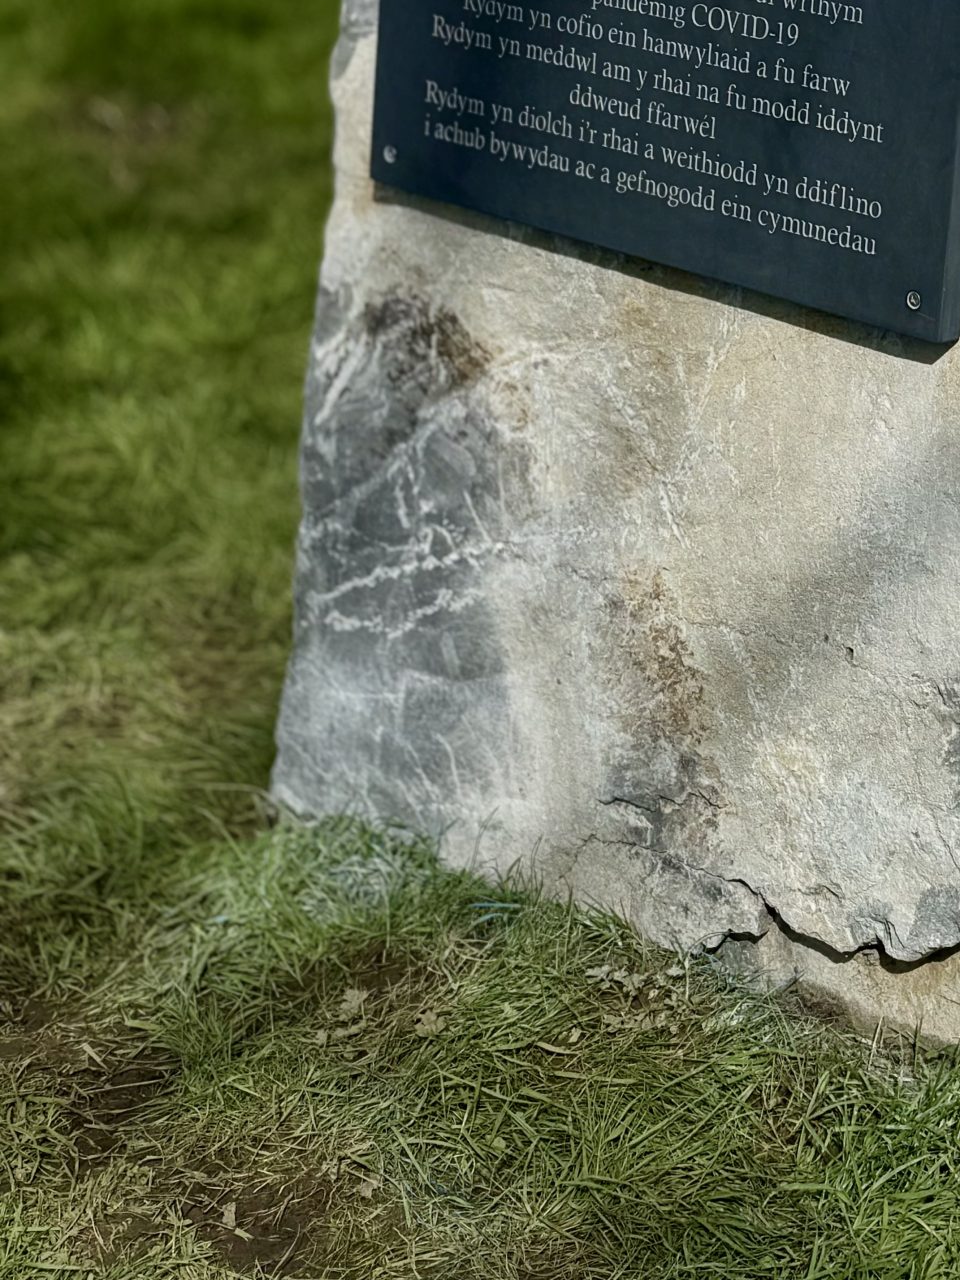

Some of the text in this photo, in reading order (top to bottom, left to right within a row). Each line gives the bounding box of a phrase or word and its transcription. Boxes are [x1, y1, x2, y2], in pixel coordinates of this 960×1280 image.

[431, 14, 885, 144] Rydym yn meddwl am y rhai na fu modd iddynt
[528, 8, 552, 31] yn
[556, 13, 604, 40] cofio
[607, 21, 637, 49] ein
[641, 27, 751, 74] hanwyliaid
[756, 61, 768, 79] a
[773, 57, 795, 84] fu
[801, 63, 851, 97] farw
[691, 3, 799, 47] COVID-19
[424, 79, 485, 116] Rydym
[490, 103, 513, 125] yn
[518, 105, 573, 139] diolch
[601, 127, 639, 156] rhai
[643, 143, 655, 161] a
[660, 146, 758, 186] weithiodd
[762, 172, 789, 196] yn
[795, 176, 882, 219] ddiflino
[569, 83, 642, 120] ddweud
[424, 111, 877, 256] i achub bywydau ac a gefnogodd ein cymunedau
